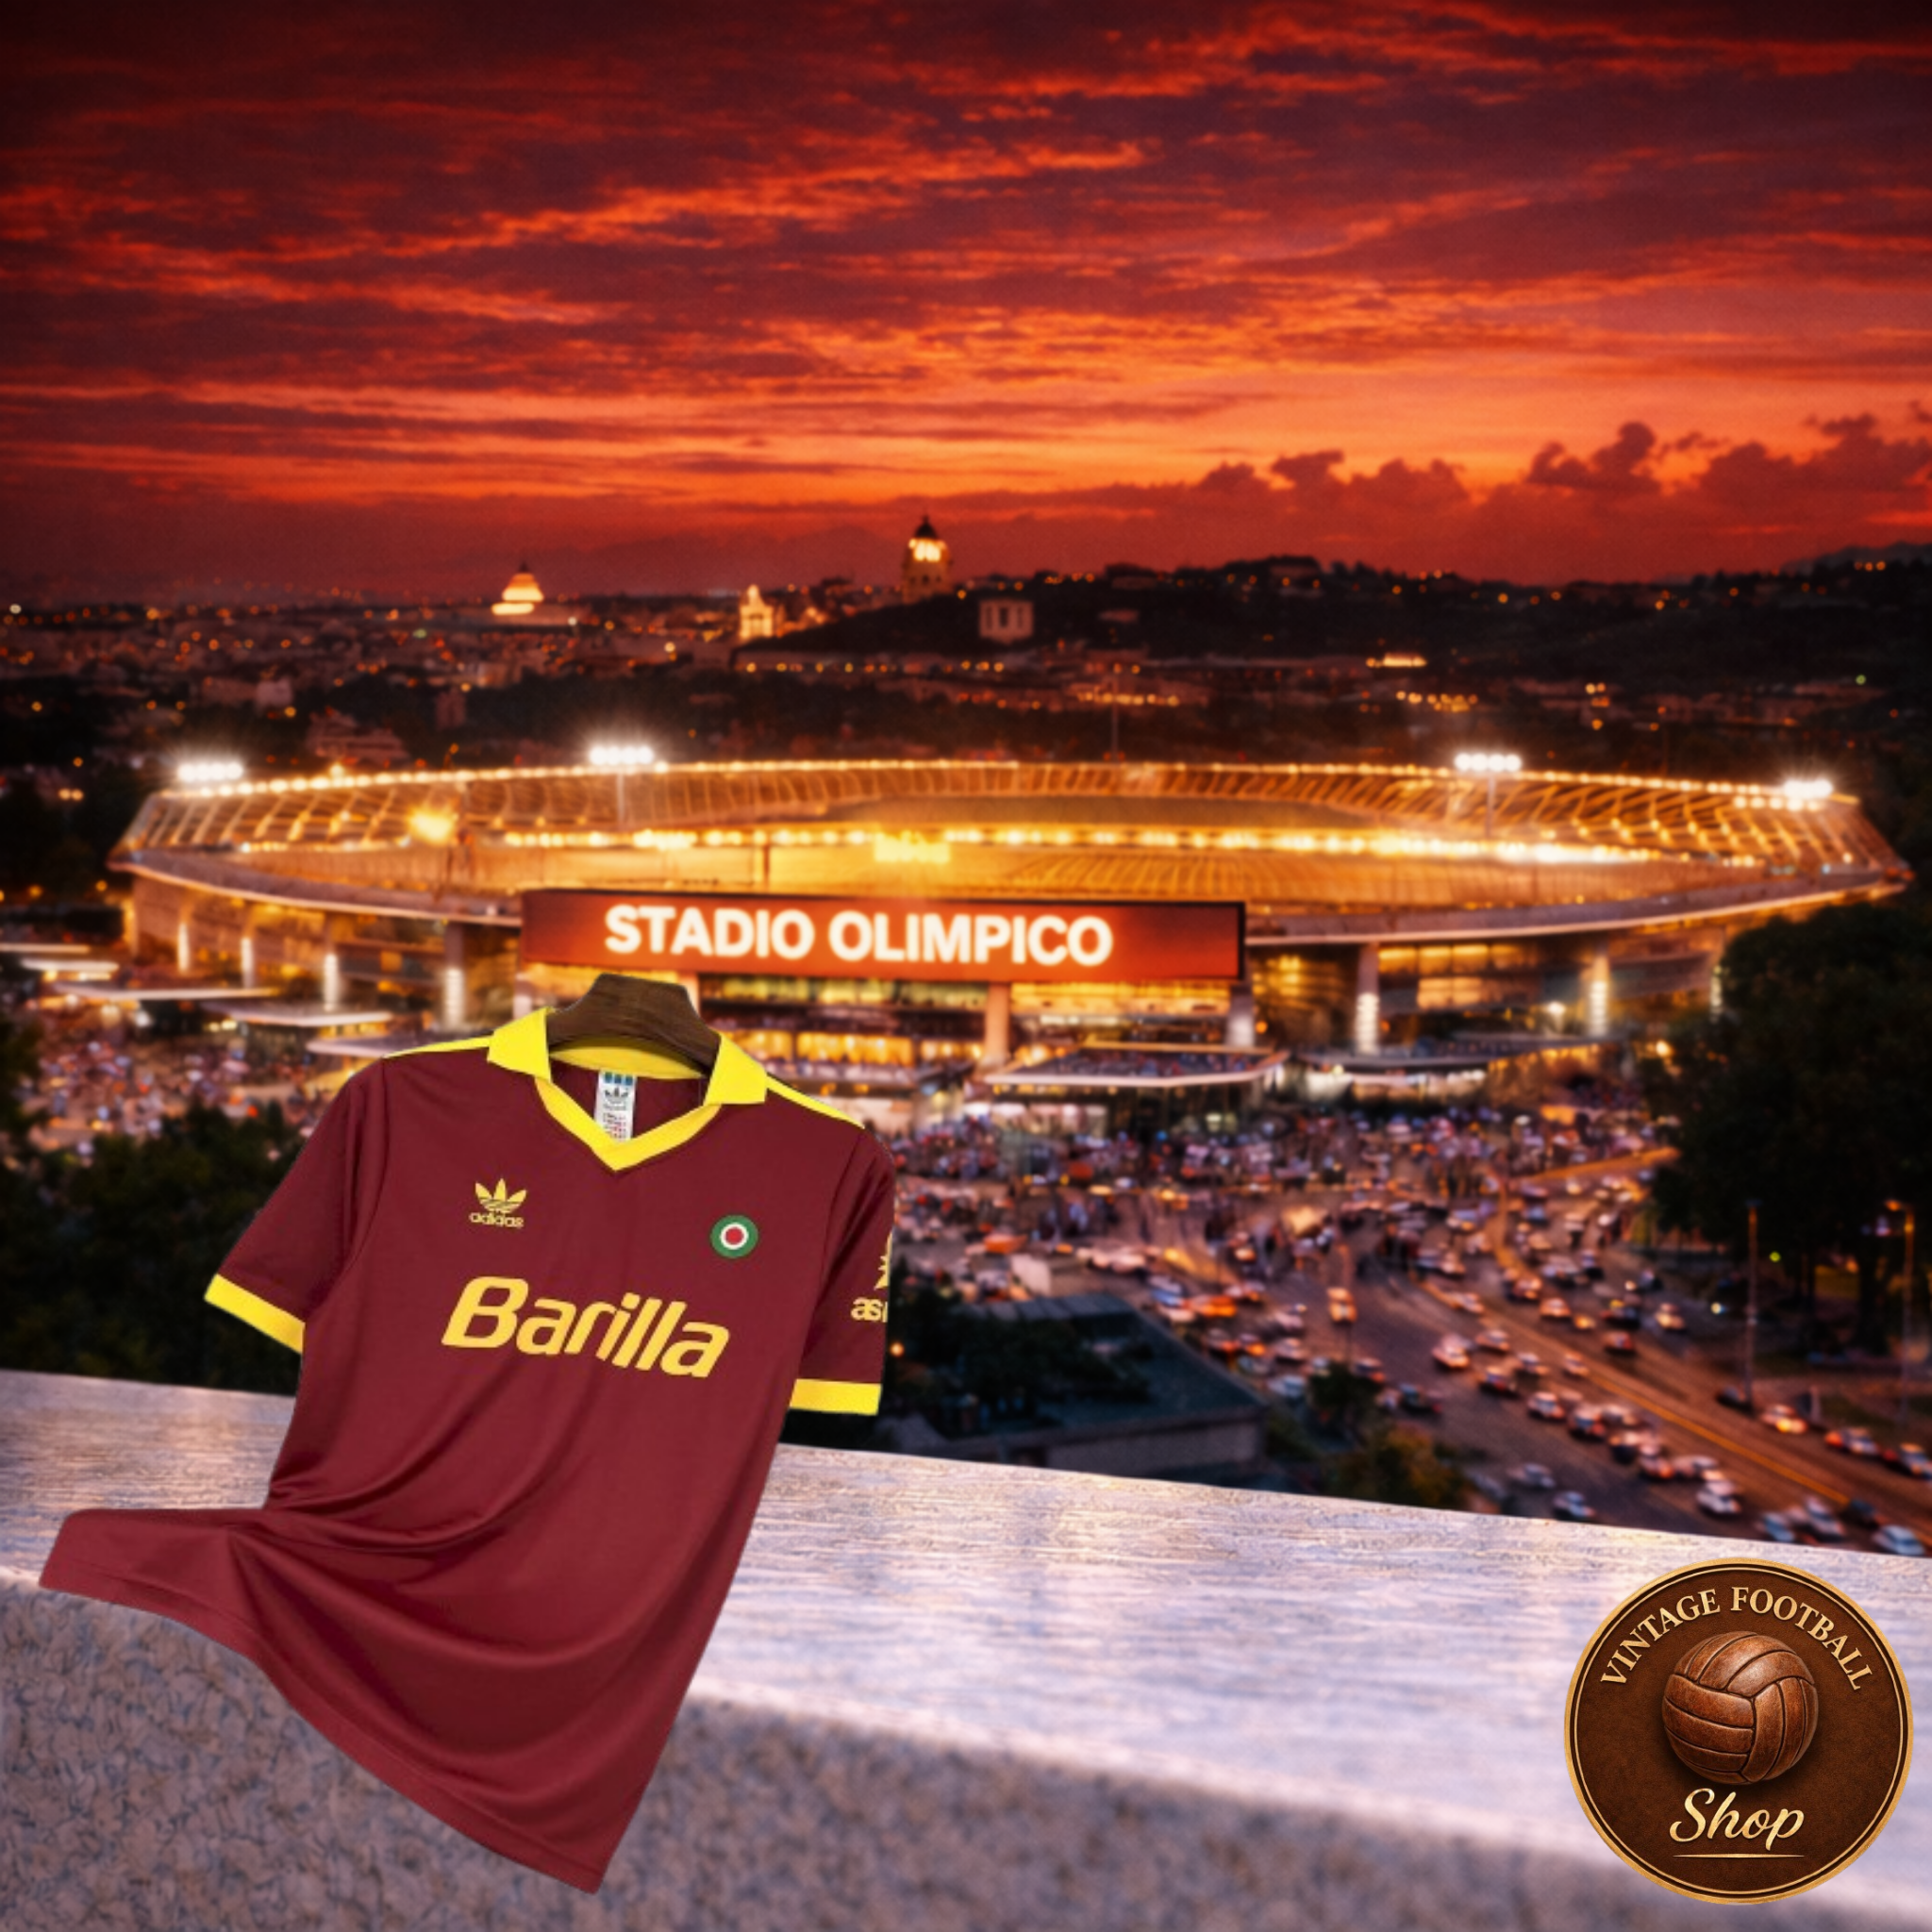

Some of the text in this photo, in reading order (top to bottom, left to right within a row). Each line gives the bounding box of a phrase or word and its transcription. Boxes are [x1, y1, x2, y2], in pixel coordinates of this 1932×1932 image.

[605, 906, 1114, 967] STADIO OLIMPICO
[469, 1211, 525, 1228] adidas
[441, 1275, 730, 1377] Barilla
